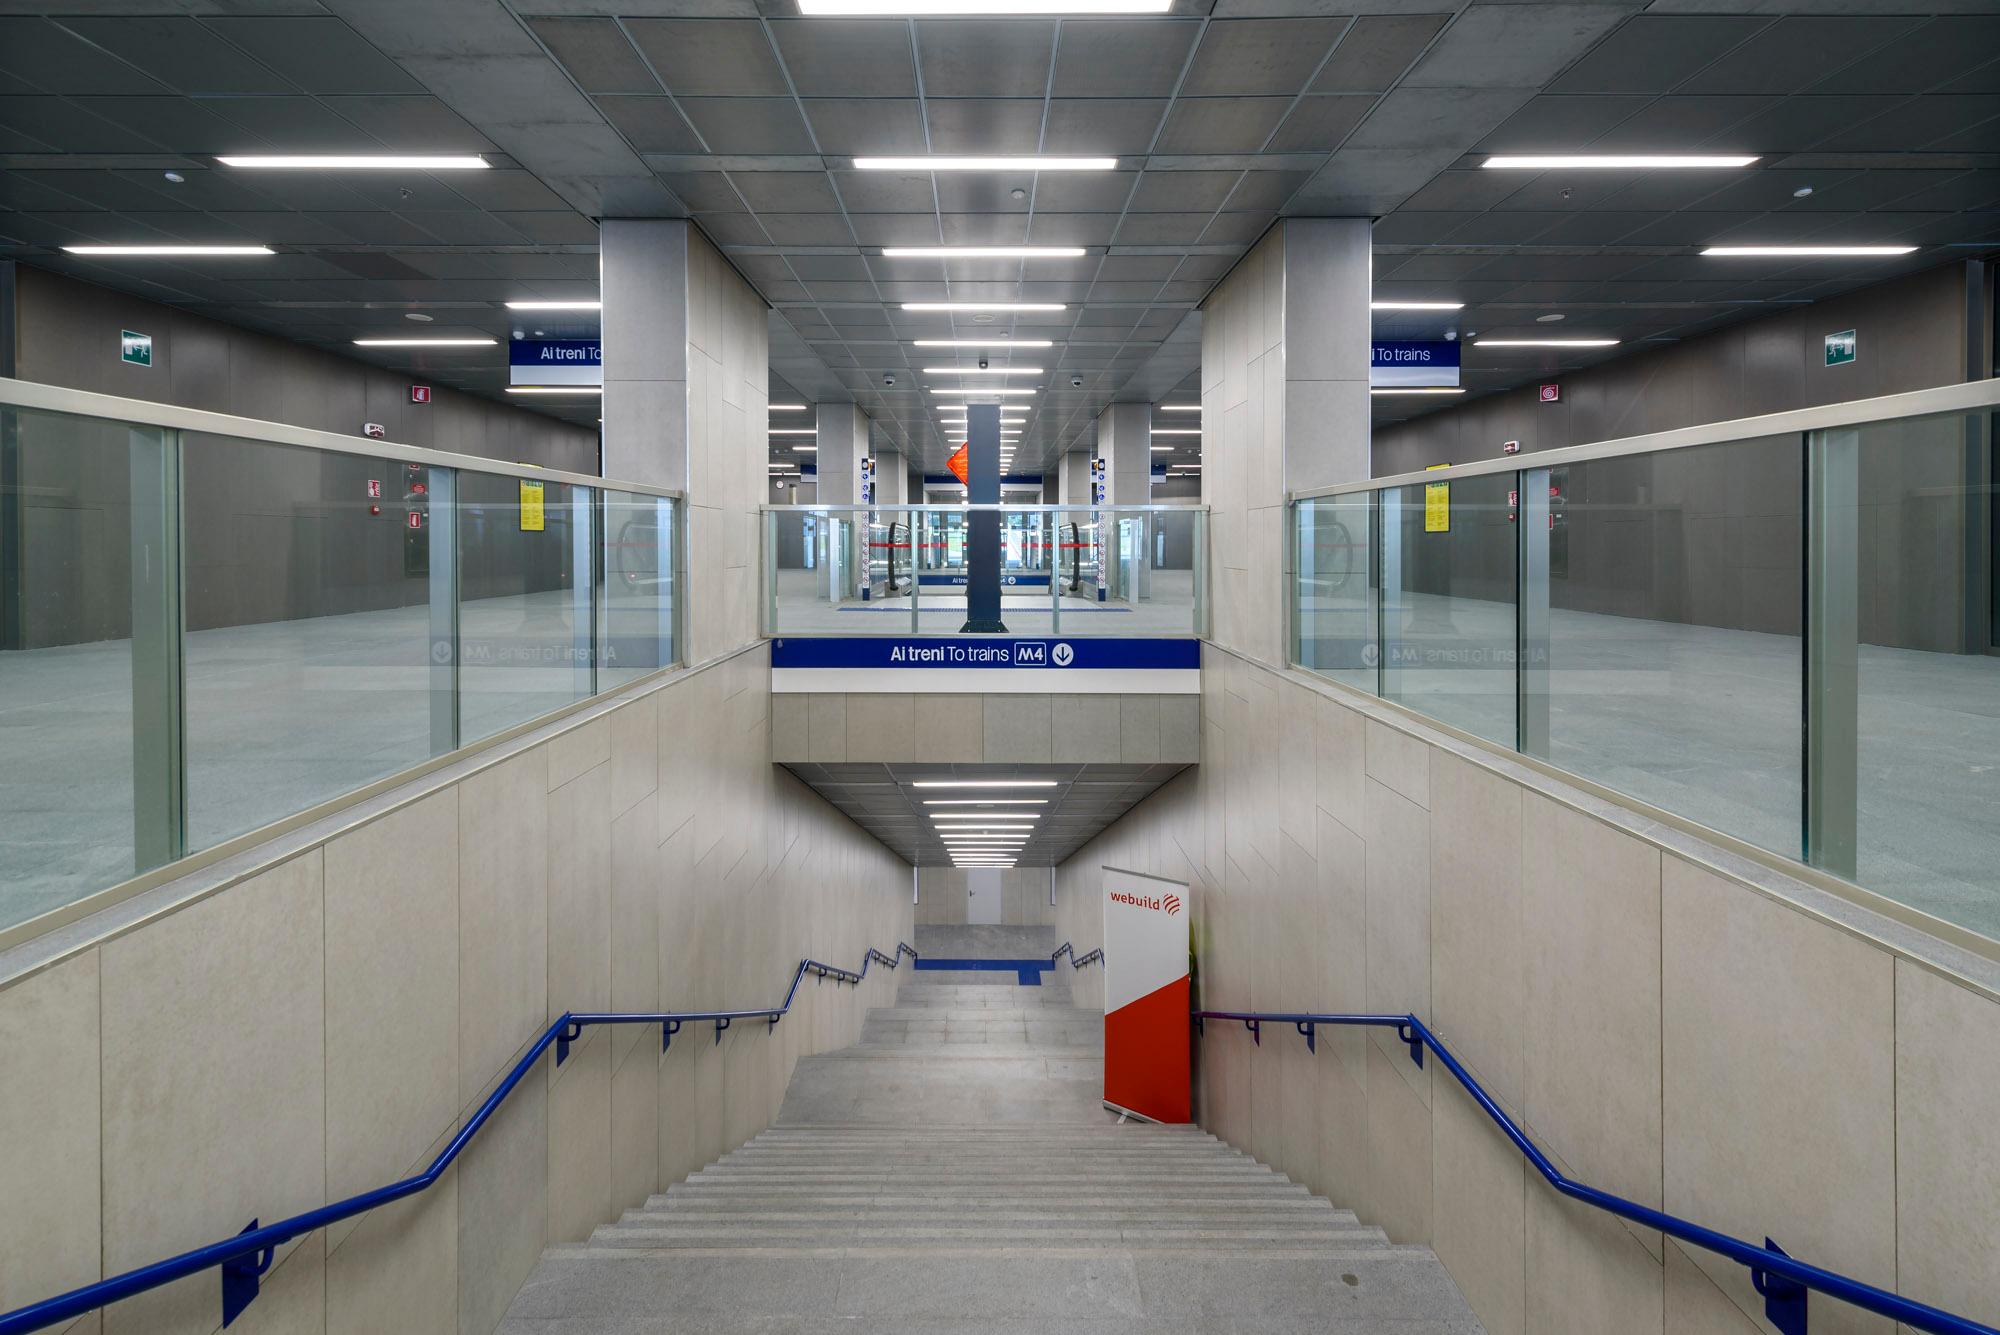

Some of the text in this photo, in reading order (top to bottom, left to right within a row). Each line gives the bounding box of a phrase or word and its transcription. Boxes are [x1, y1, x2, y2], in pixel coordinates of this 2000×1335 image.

[540, 346, 553, 360] Ai
[555, 346, 586, 360] treni
[1377, 348, 1392, 361] To
[1394, 348, 1431, 361] trains
[890, 646, 1044, 661] Ai treni To trains M4
[1110, 892, 1160, 910] webuild
